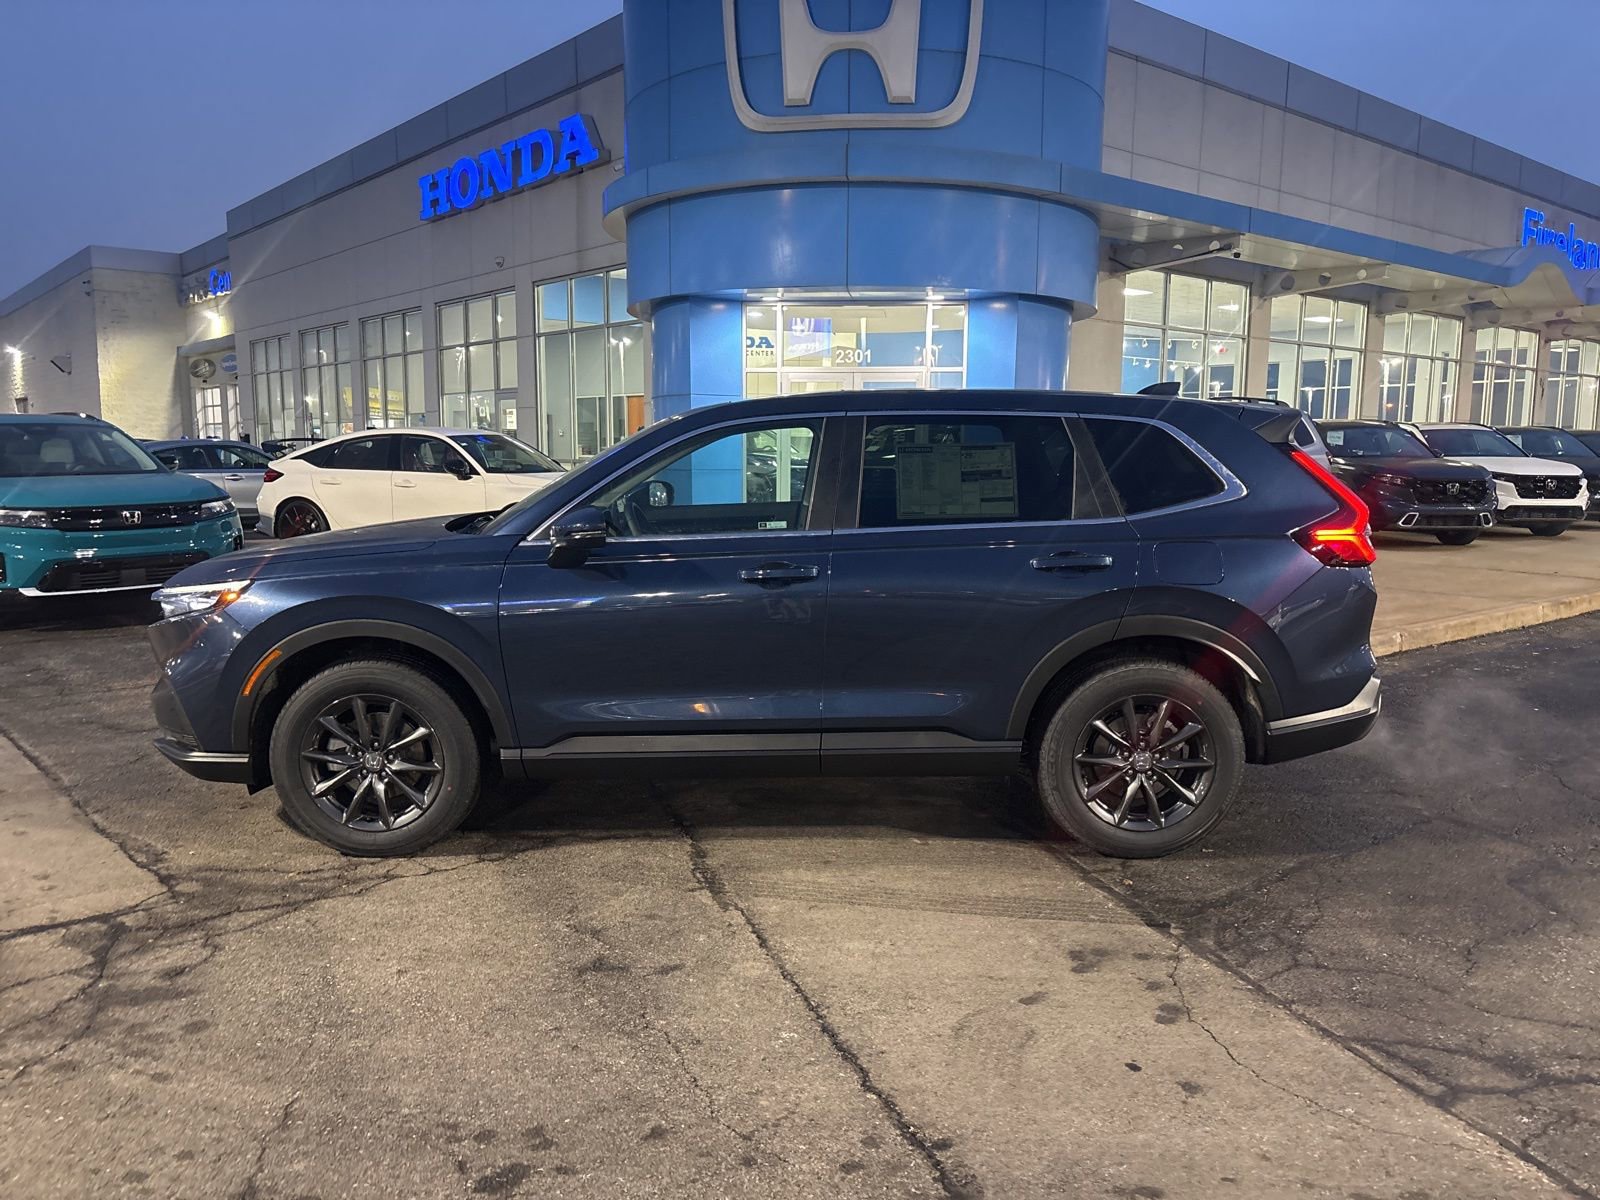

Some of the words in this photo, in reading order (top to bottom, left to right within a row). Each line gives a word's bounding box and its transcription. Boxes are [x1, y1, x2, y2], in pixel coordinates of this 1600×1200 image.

[418, 112, 599, 221] HONDA
[1521, 207, 1600, 270] Firelan
[835, 349, 872, 364] 2301
